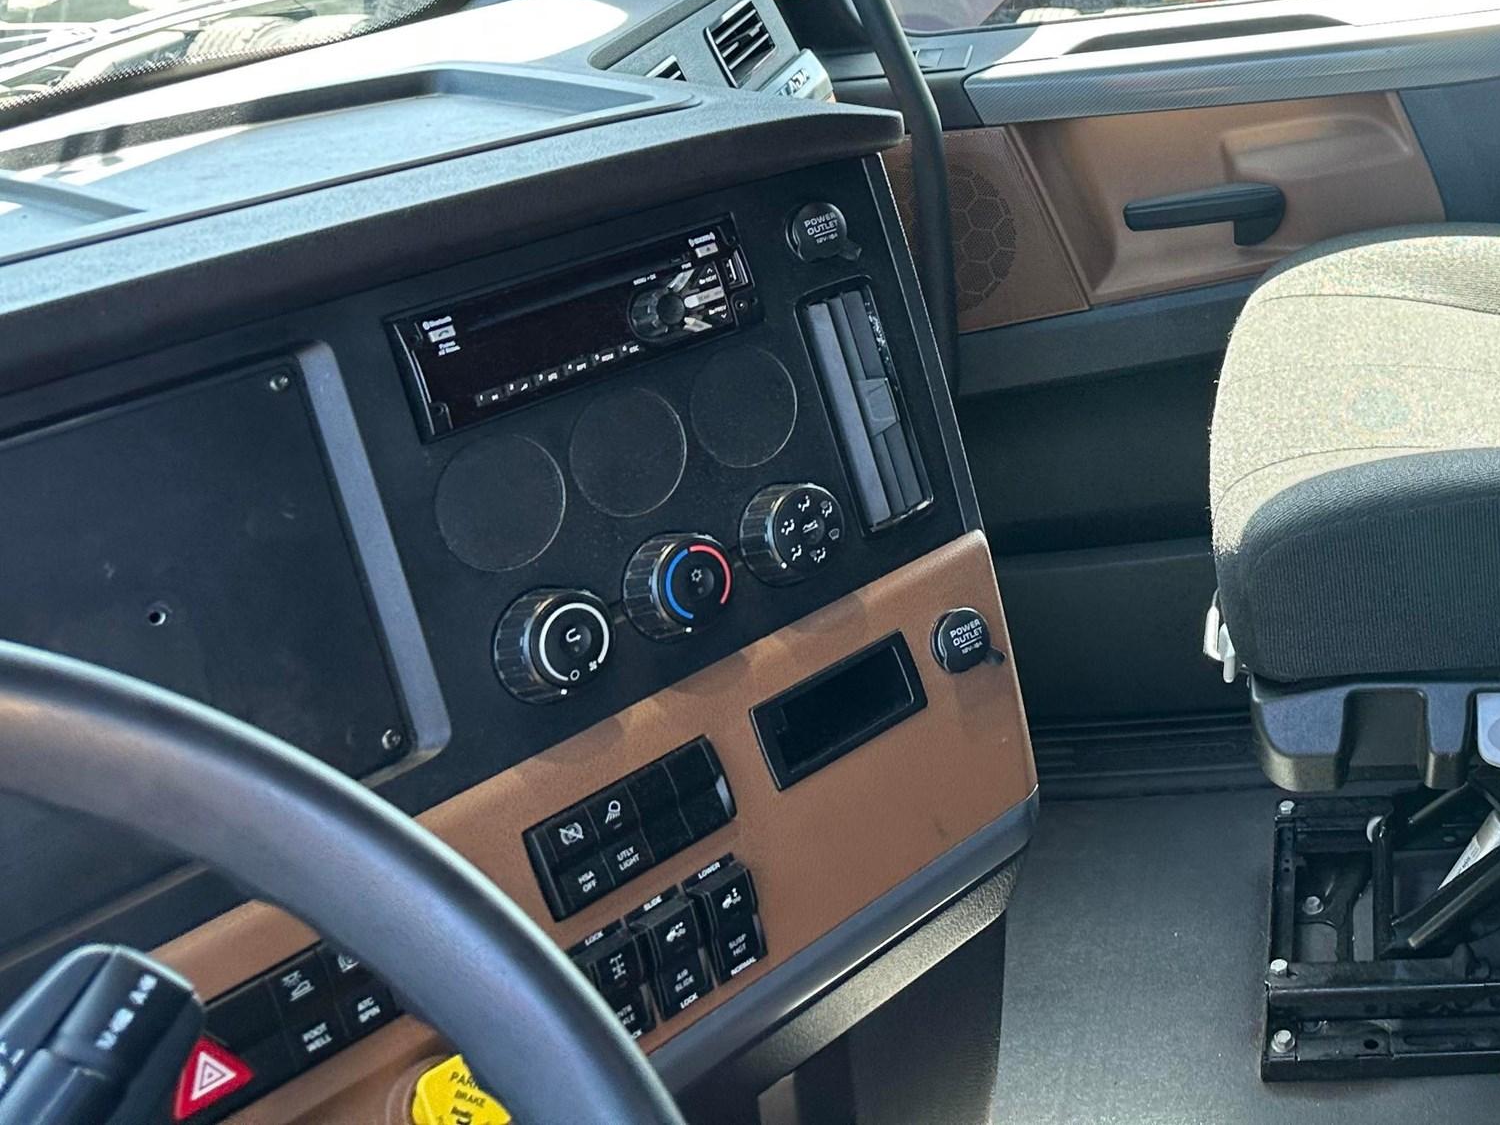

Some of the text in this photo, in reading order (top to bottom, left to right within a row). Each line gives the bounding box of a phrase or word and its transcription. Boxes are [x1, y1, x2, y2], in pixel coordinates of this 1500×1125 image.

[804, 212, 836, 228] POWER
[807, 220, 838, 236] OUTLET
[950, 619, 980, 638] POWER
[953, 627, 983, 646] OUTLET
[616, 846, 635, 862] UTLY
[619, 853, 640, 871] LIGHT
[698, 862, 721, 880] LOWER
[582, 879, 597, 893] OFF
[643, 895, 662, 912] SLIDE
[585, 931, 604, 946] LOCK
[730, 956, 757, 976] NORMAL
[676, 969, 689, 981] AIR
[675, 976, 694, 992] SLIDE
[680, 992, 699, 1009] LOCK
[454, 1089, 486, 1108] BRAKE
